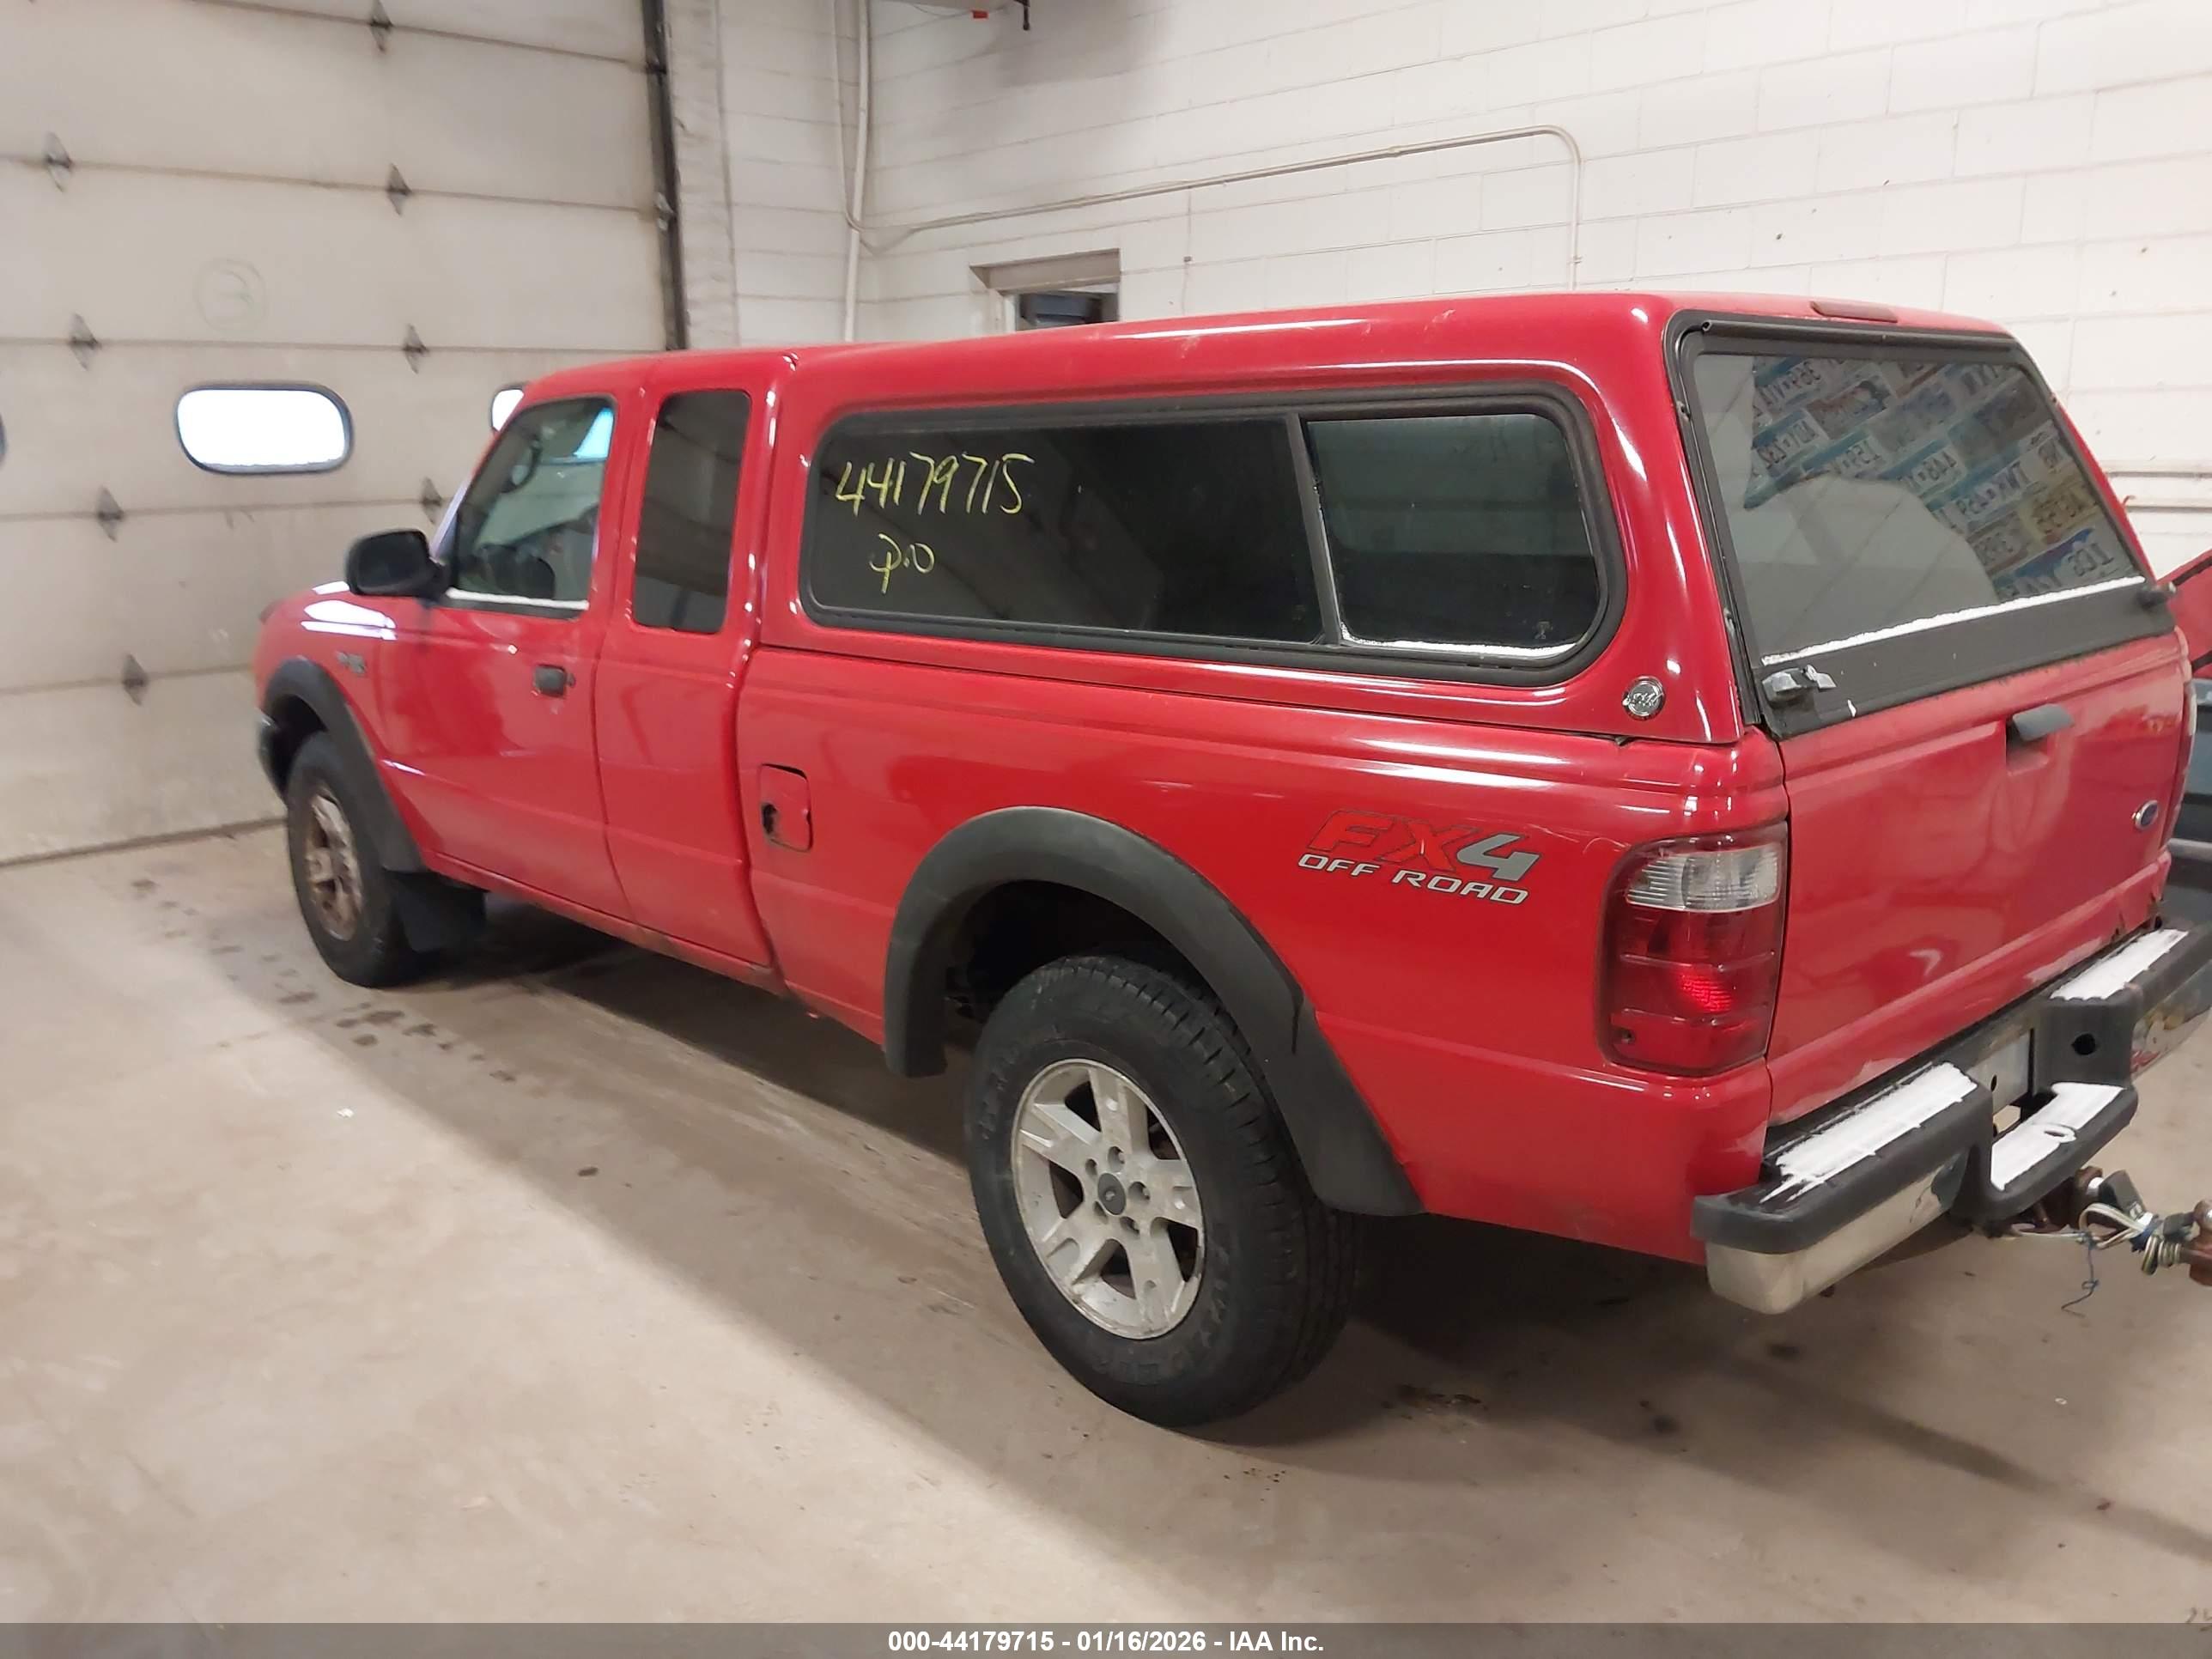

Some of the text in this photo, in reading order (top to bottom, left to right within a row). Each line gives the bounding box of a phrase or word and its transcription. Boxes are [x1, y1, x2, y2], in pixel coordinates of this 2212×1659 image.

[836, 451, 1036, 517] 44179715
[1305, 808, 1543, 883] FX4
[1297, 852, 1531, 906] OFF ROAD
